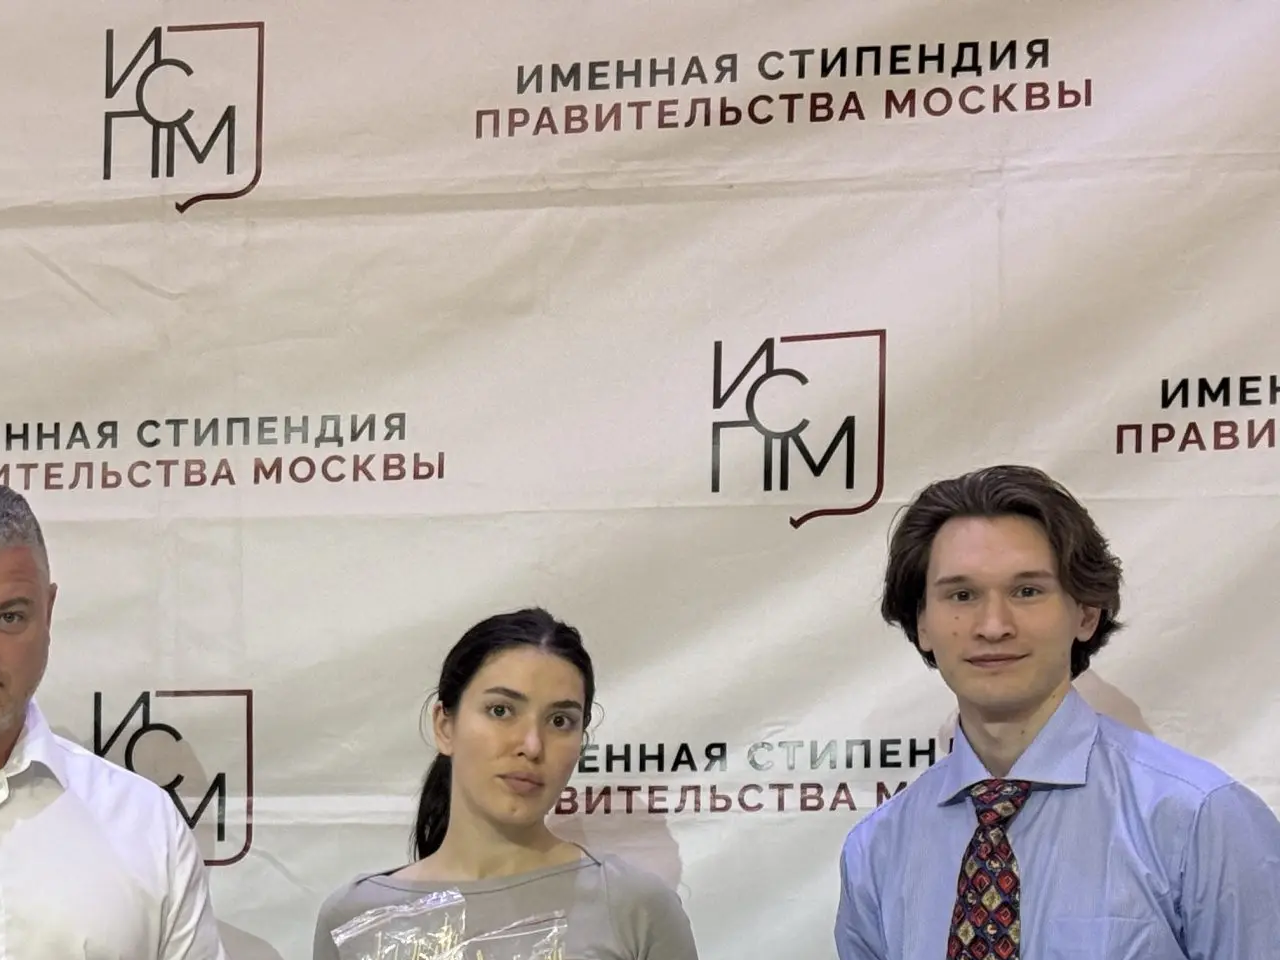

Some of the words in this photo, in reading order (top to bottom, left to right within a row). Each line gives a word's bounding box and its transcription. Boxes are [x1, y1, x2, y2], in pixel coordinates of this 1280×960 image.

[517, 53, 738, 94] ИМЕННАЯ
[758, 38, 1050, 80] СТИПЕНДИЯ
[476, 94, 865, 139] ПРАВИТЕЛЬСТВА
[885, 78, 1094, 118] МОСКВЫ
[136, 413, 406, 448] СТИПЕНДИЯ
[1116, 418, 1276, 455] ПРАВИ
[253, 452, 445, 485] МОСКВЫ
[747, 738, 954, 771] СТИПЕН
